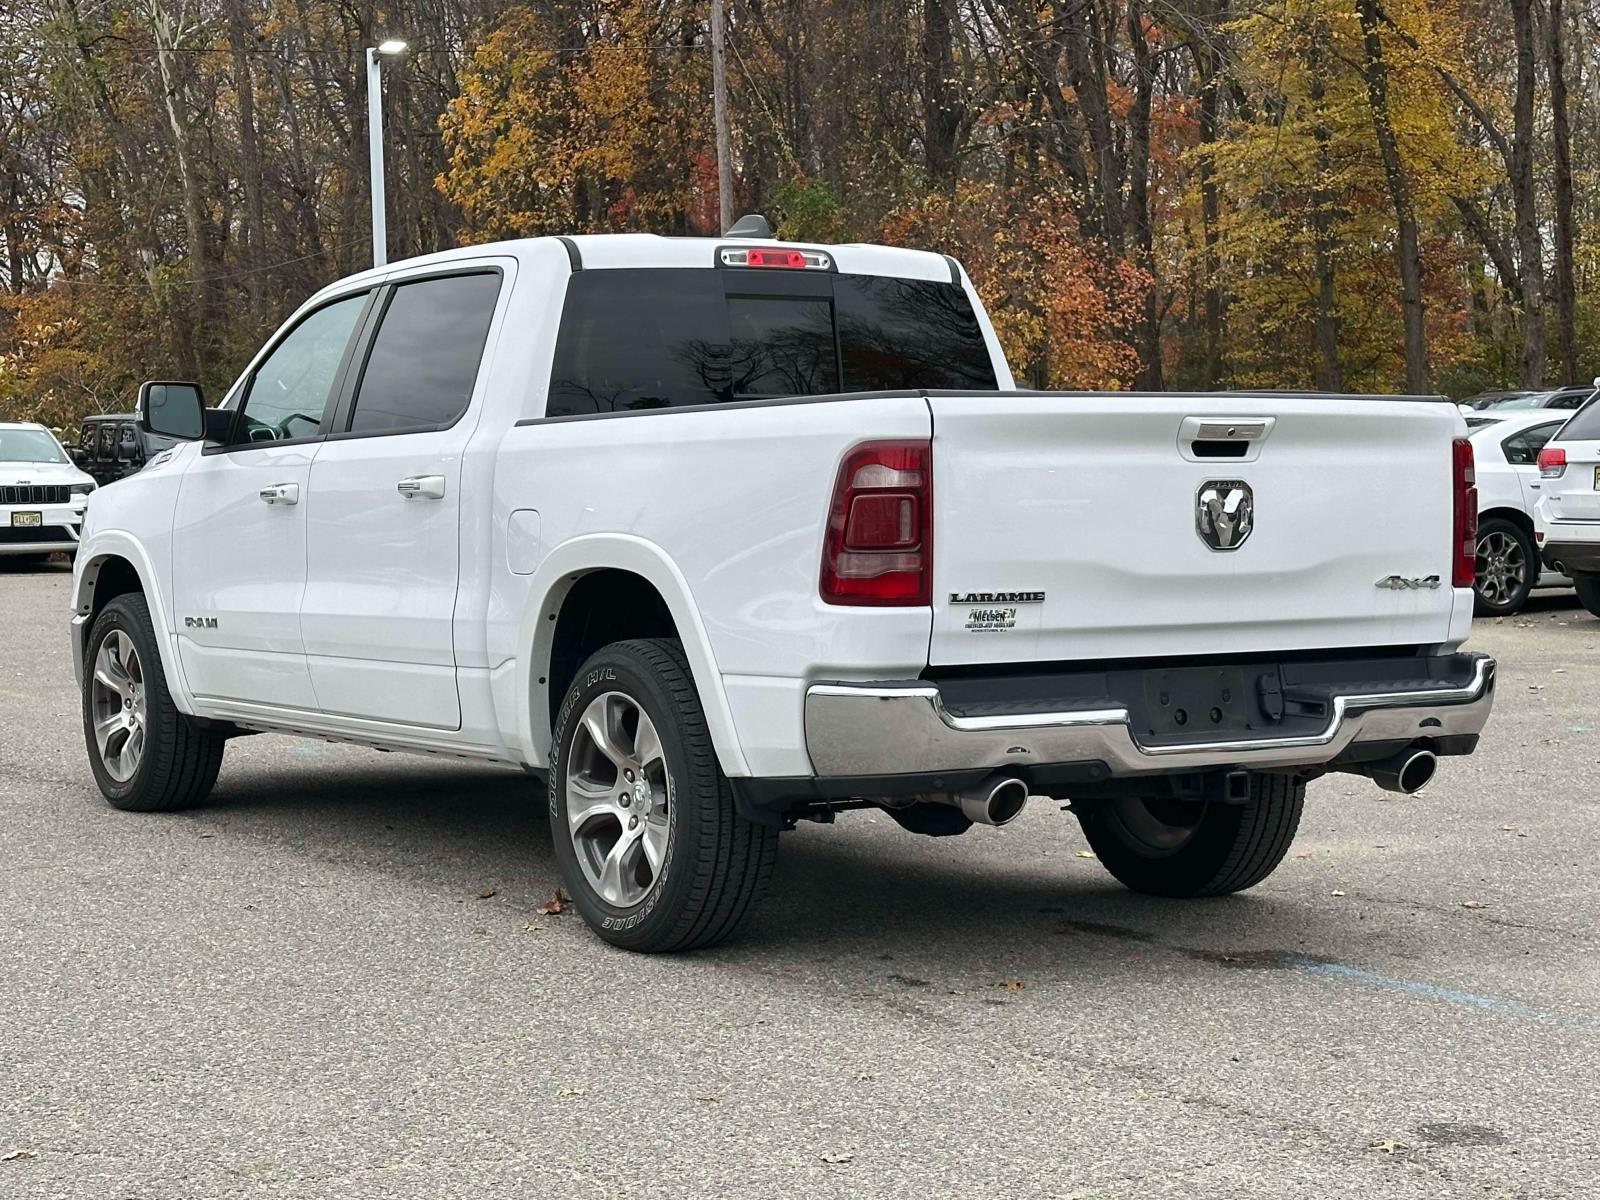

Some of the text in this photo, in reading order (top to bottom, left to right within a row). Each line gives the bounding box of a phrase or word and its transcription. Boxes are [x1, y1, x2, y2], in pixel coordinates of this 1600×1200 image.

[1374, 575, 1441, 590] 4x4
[948, 591, 1045, 604] LARAMIE
[184, 616, 218, 629] RAM
[587, 668, 617, 688] H/L
